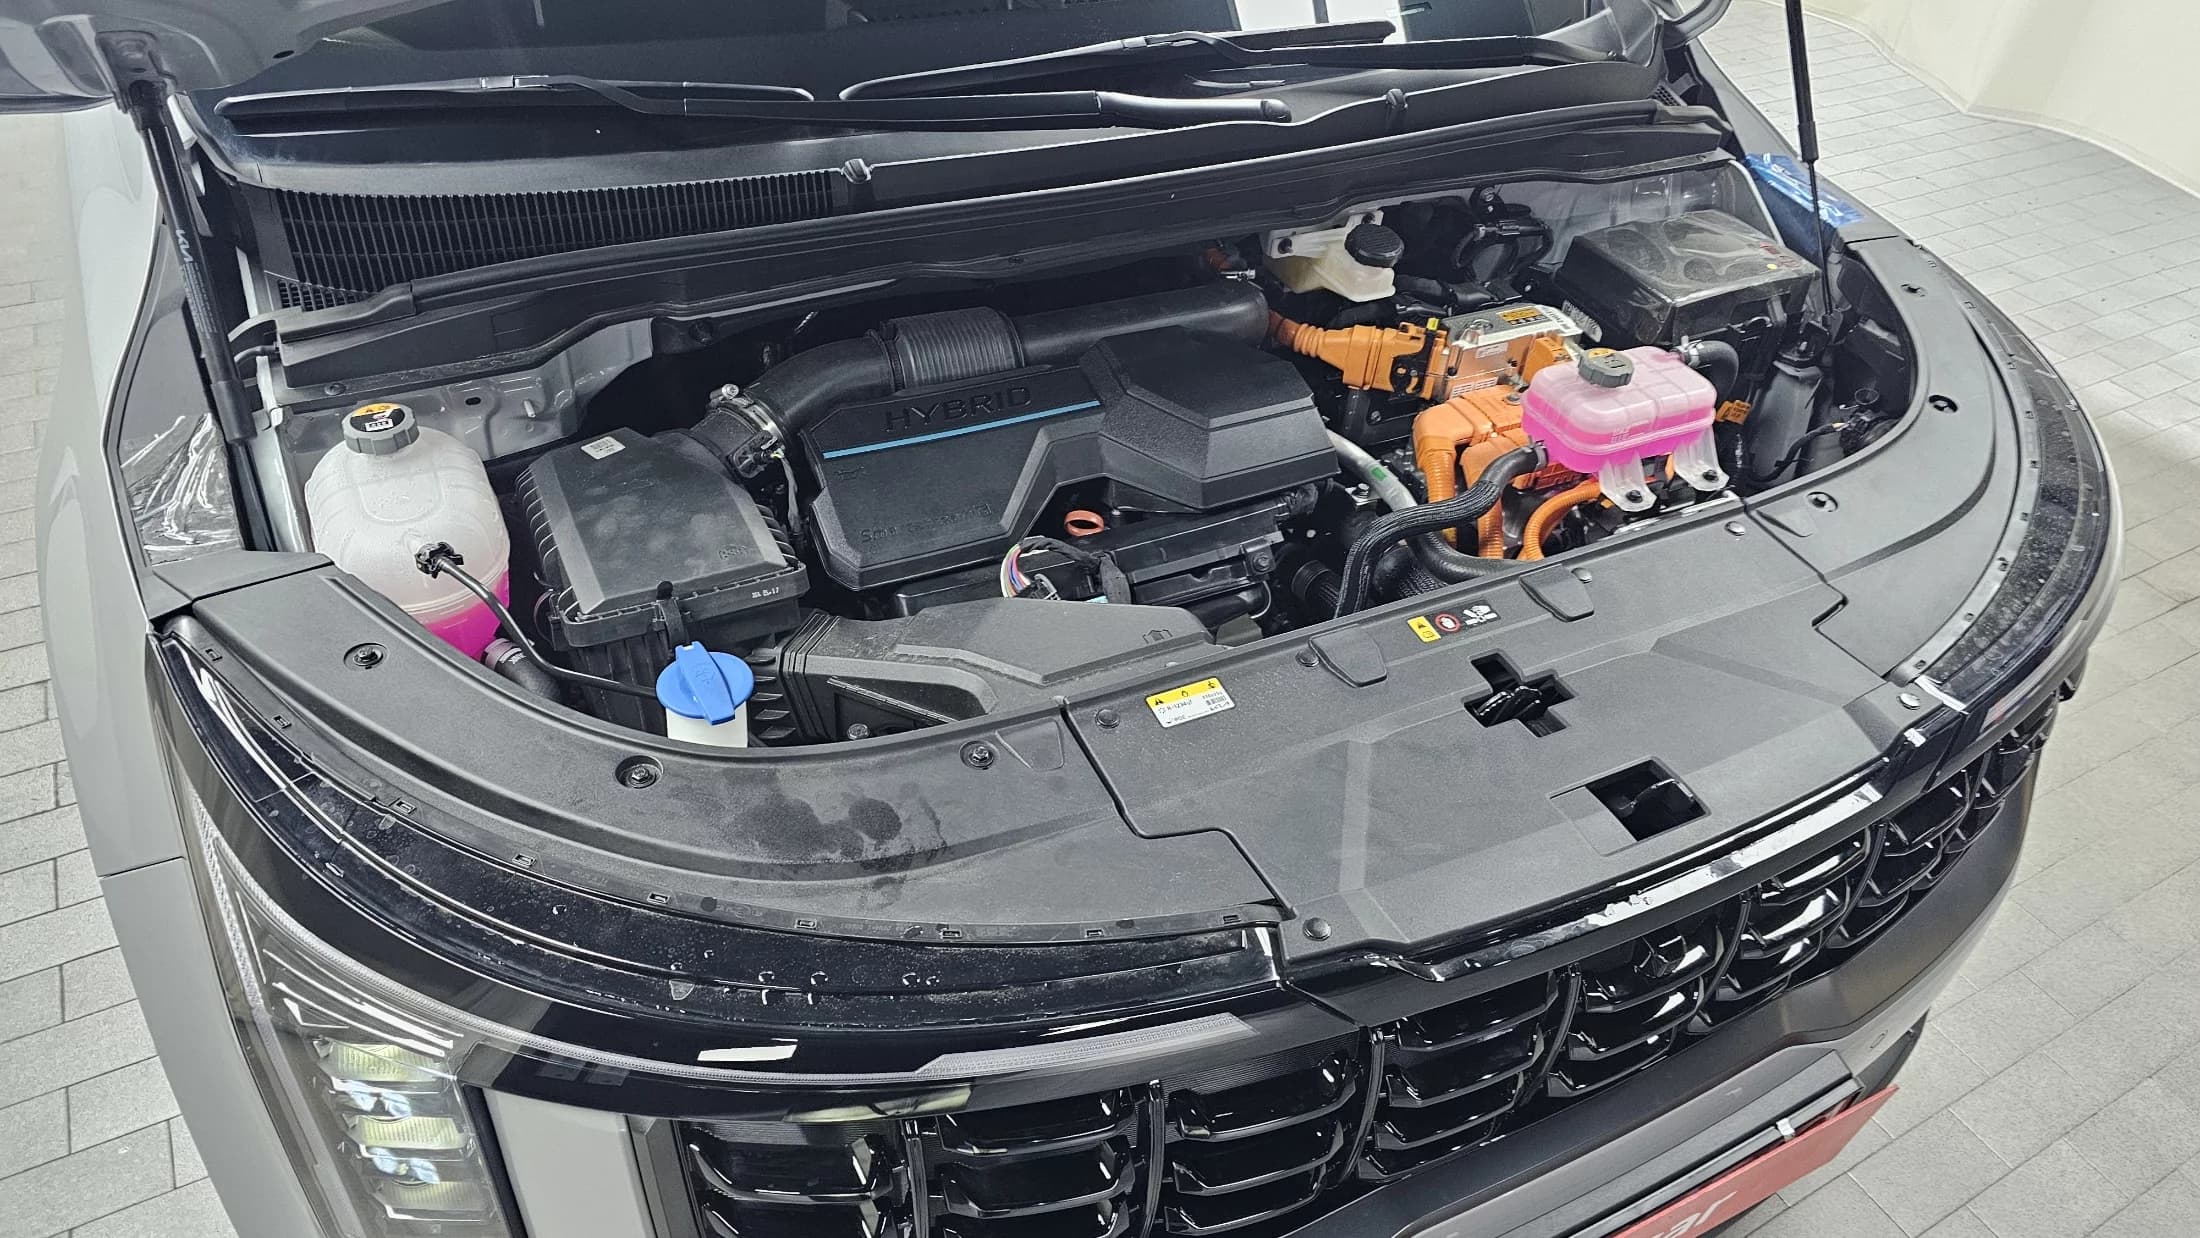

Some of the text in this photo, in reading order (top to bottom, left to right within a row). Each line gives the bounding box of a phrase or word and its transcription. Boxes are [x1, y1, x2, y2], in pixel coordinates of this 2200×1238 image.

[175, 228, 194, 263] KIA
[881, 386, 1032, 432] HYBRID
[1652, 1190, 1738, 1238] ar
